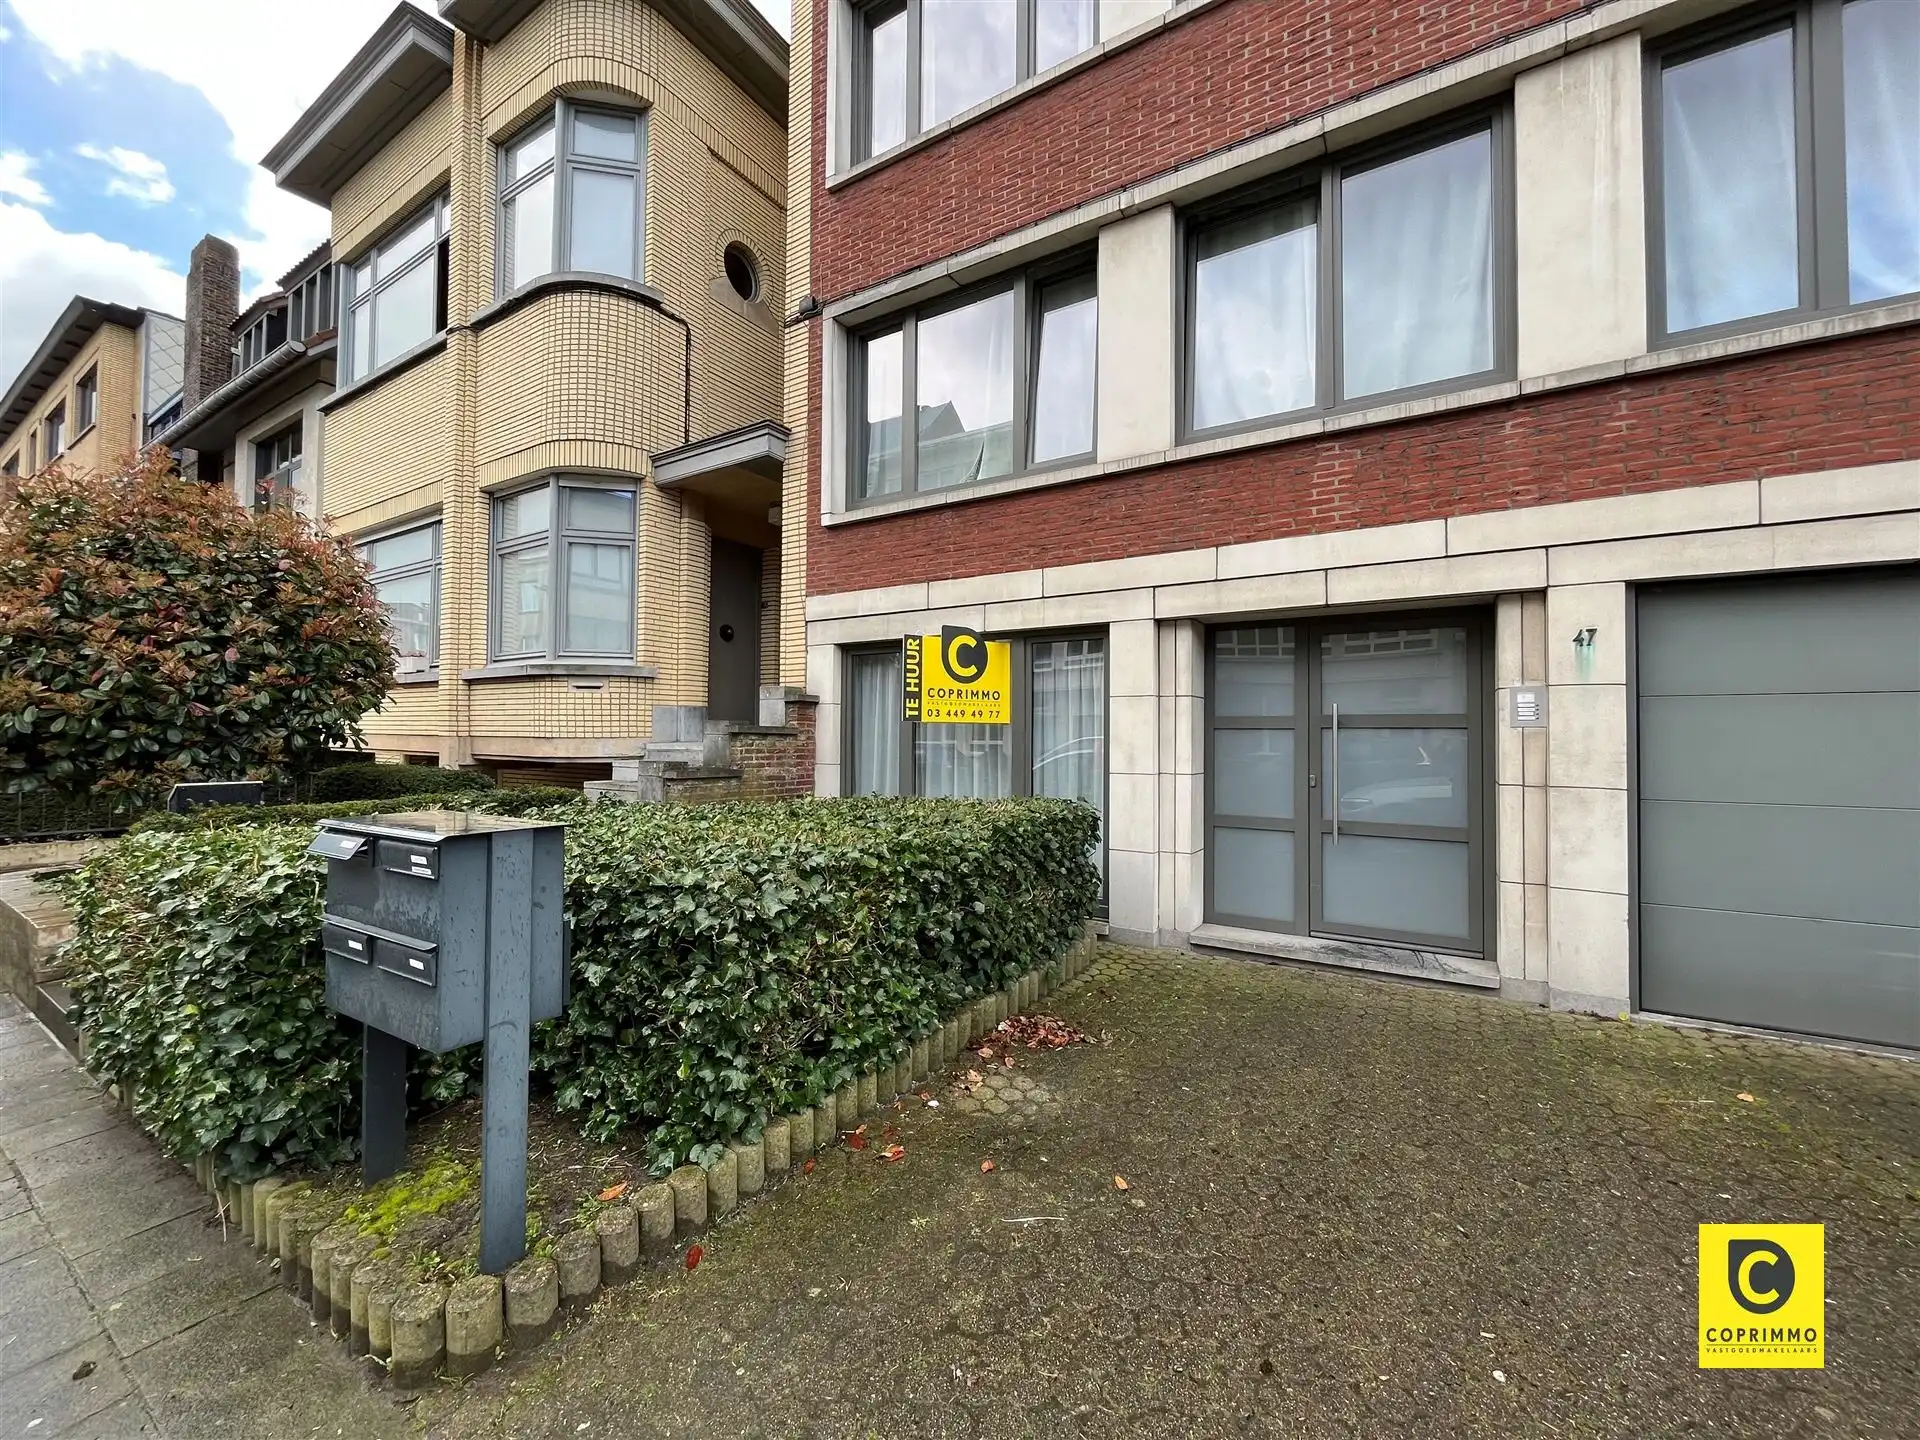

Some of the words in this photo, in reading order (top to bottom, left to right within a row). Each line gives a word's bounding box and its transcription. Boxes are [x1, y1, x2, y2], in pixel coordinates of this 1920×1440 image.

[1572, 628, 1598, 647] 47
[906, 638, 920, 692] HUUR
[927, 688, 1001, 701] COPRIMMO
[905, 698, 919, 718] TE
[927, 708, 940, 717] 03
[946, 709, 966, 718] 449
[971, 710, 983, 718] 49
[988, 710, 1001, 719] 77
